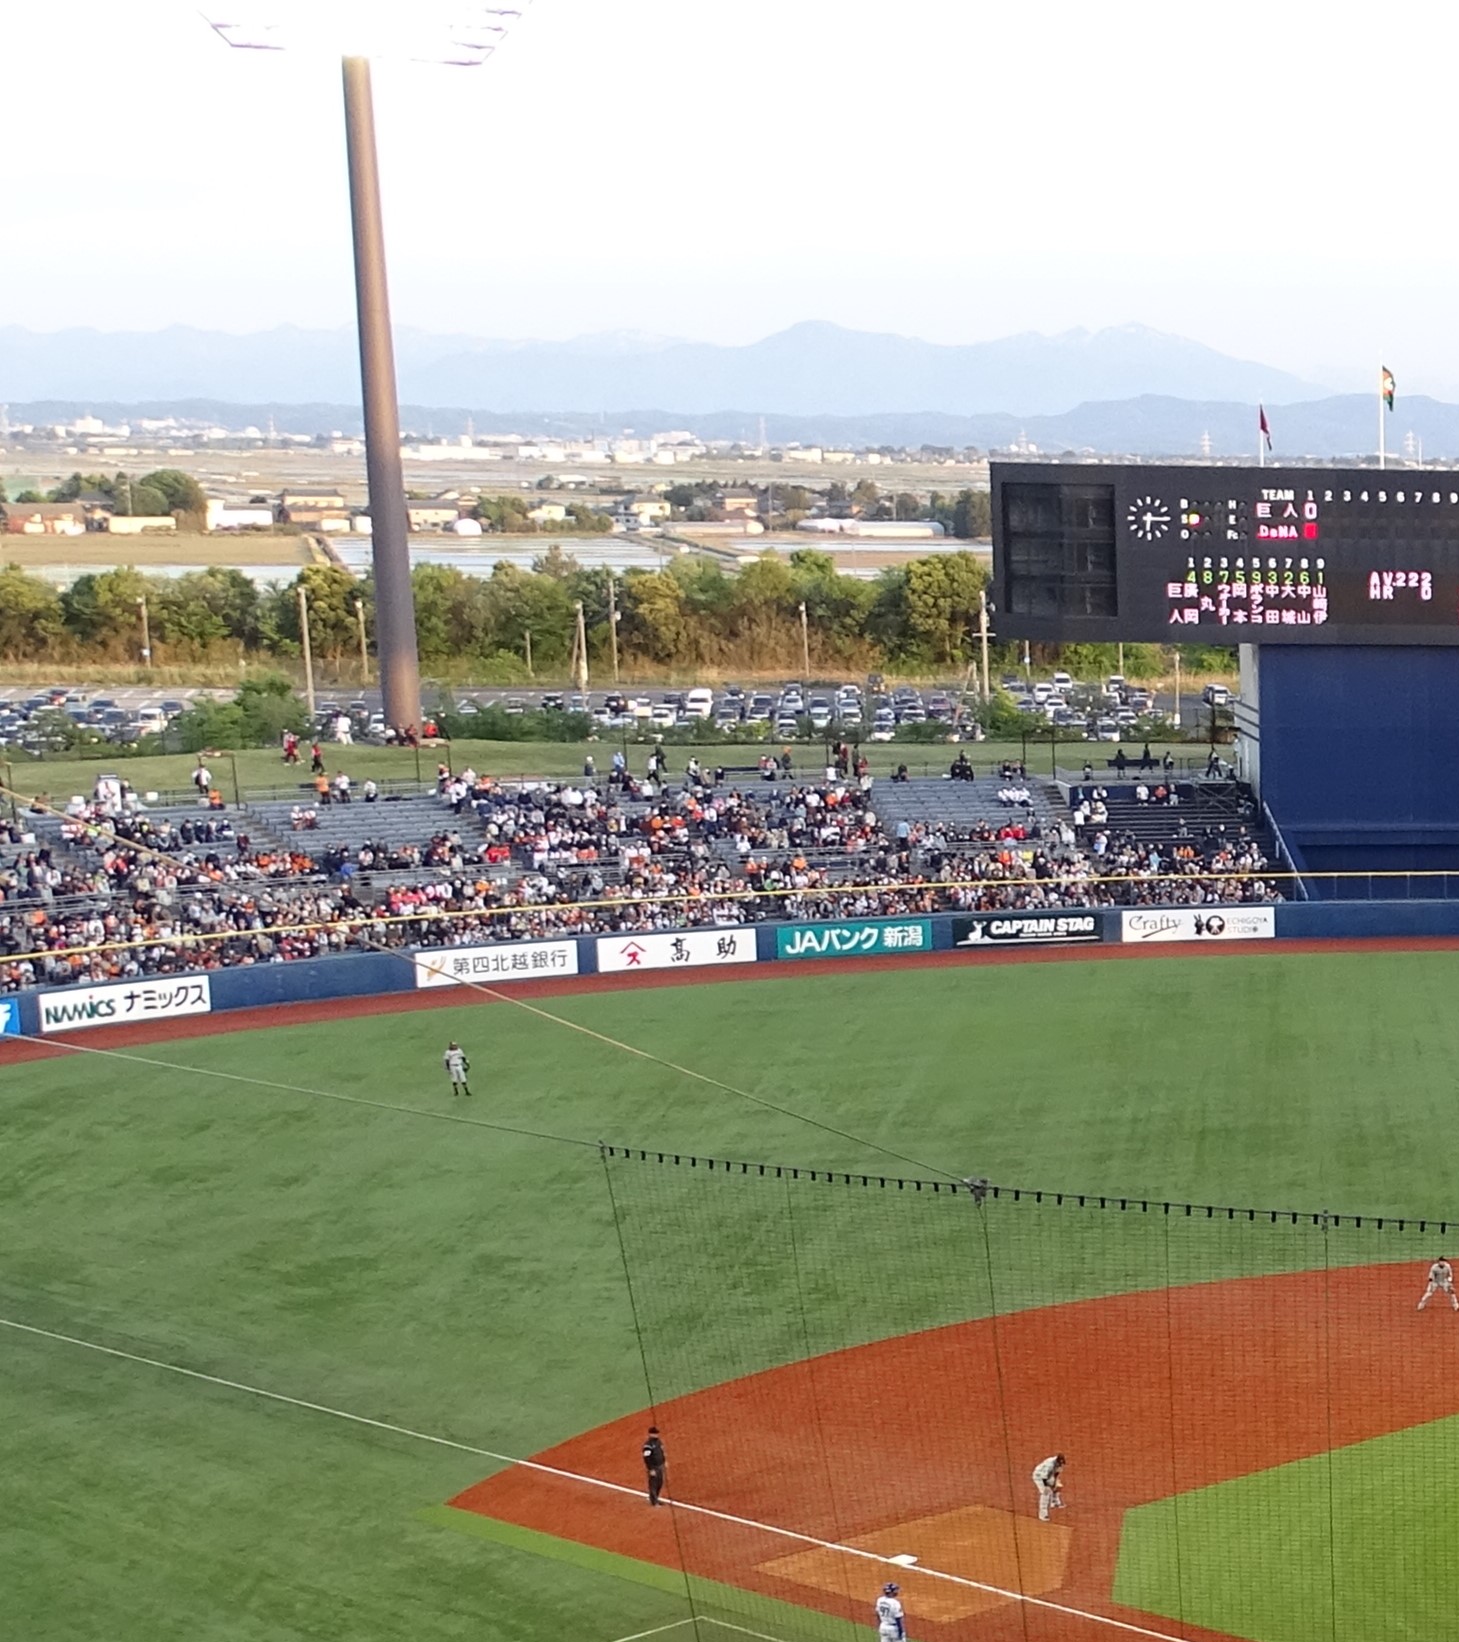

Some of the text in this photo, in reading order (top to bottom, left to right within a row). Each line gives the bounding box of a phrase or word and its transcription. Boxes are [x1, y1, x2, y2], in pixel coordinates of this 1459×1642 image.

[1262, 489, 1295, 501] TEAM
[1306, 490, 1315, 501] 1
[1324, 490, 1333, 501] 2
[1343, 490, 1351, 501] 3
[1361, 490, 1369, 502] 4
[1378, 491, 1387, 502] 5
[1396, 491, 1405, 502] 6
[1414, 491, 1423, 502] 7
[1432, 492, 1440, 503] 8
[1450, 492, 1458, 503] 9
[1256, 502, 1298, 519] 巨人
[1304, 502, 1317, 520] 0
[1187, 557, 1325, 570] 1 2 3 4 5 6 7 8 9
[1187, 571, 1324, 584] 4 8 7 5 9 3 2 6 1
[1369, 586, 1433, 600] HR 0
[990, 917, 1095, 934] CAPTAIN STAG
[1129, 914, 1181, 934] Crafty
[785, 925, 924, 954] JAバンク 新潟
[453, 949, 568, 975] 第四北越銀行
[124, 984, 206, 1013] ナミックス
